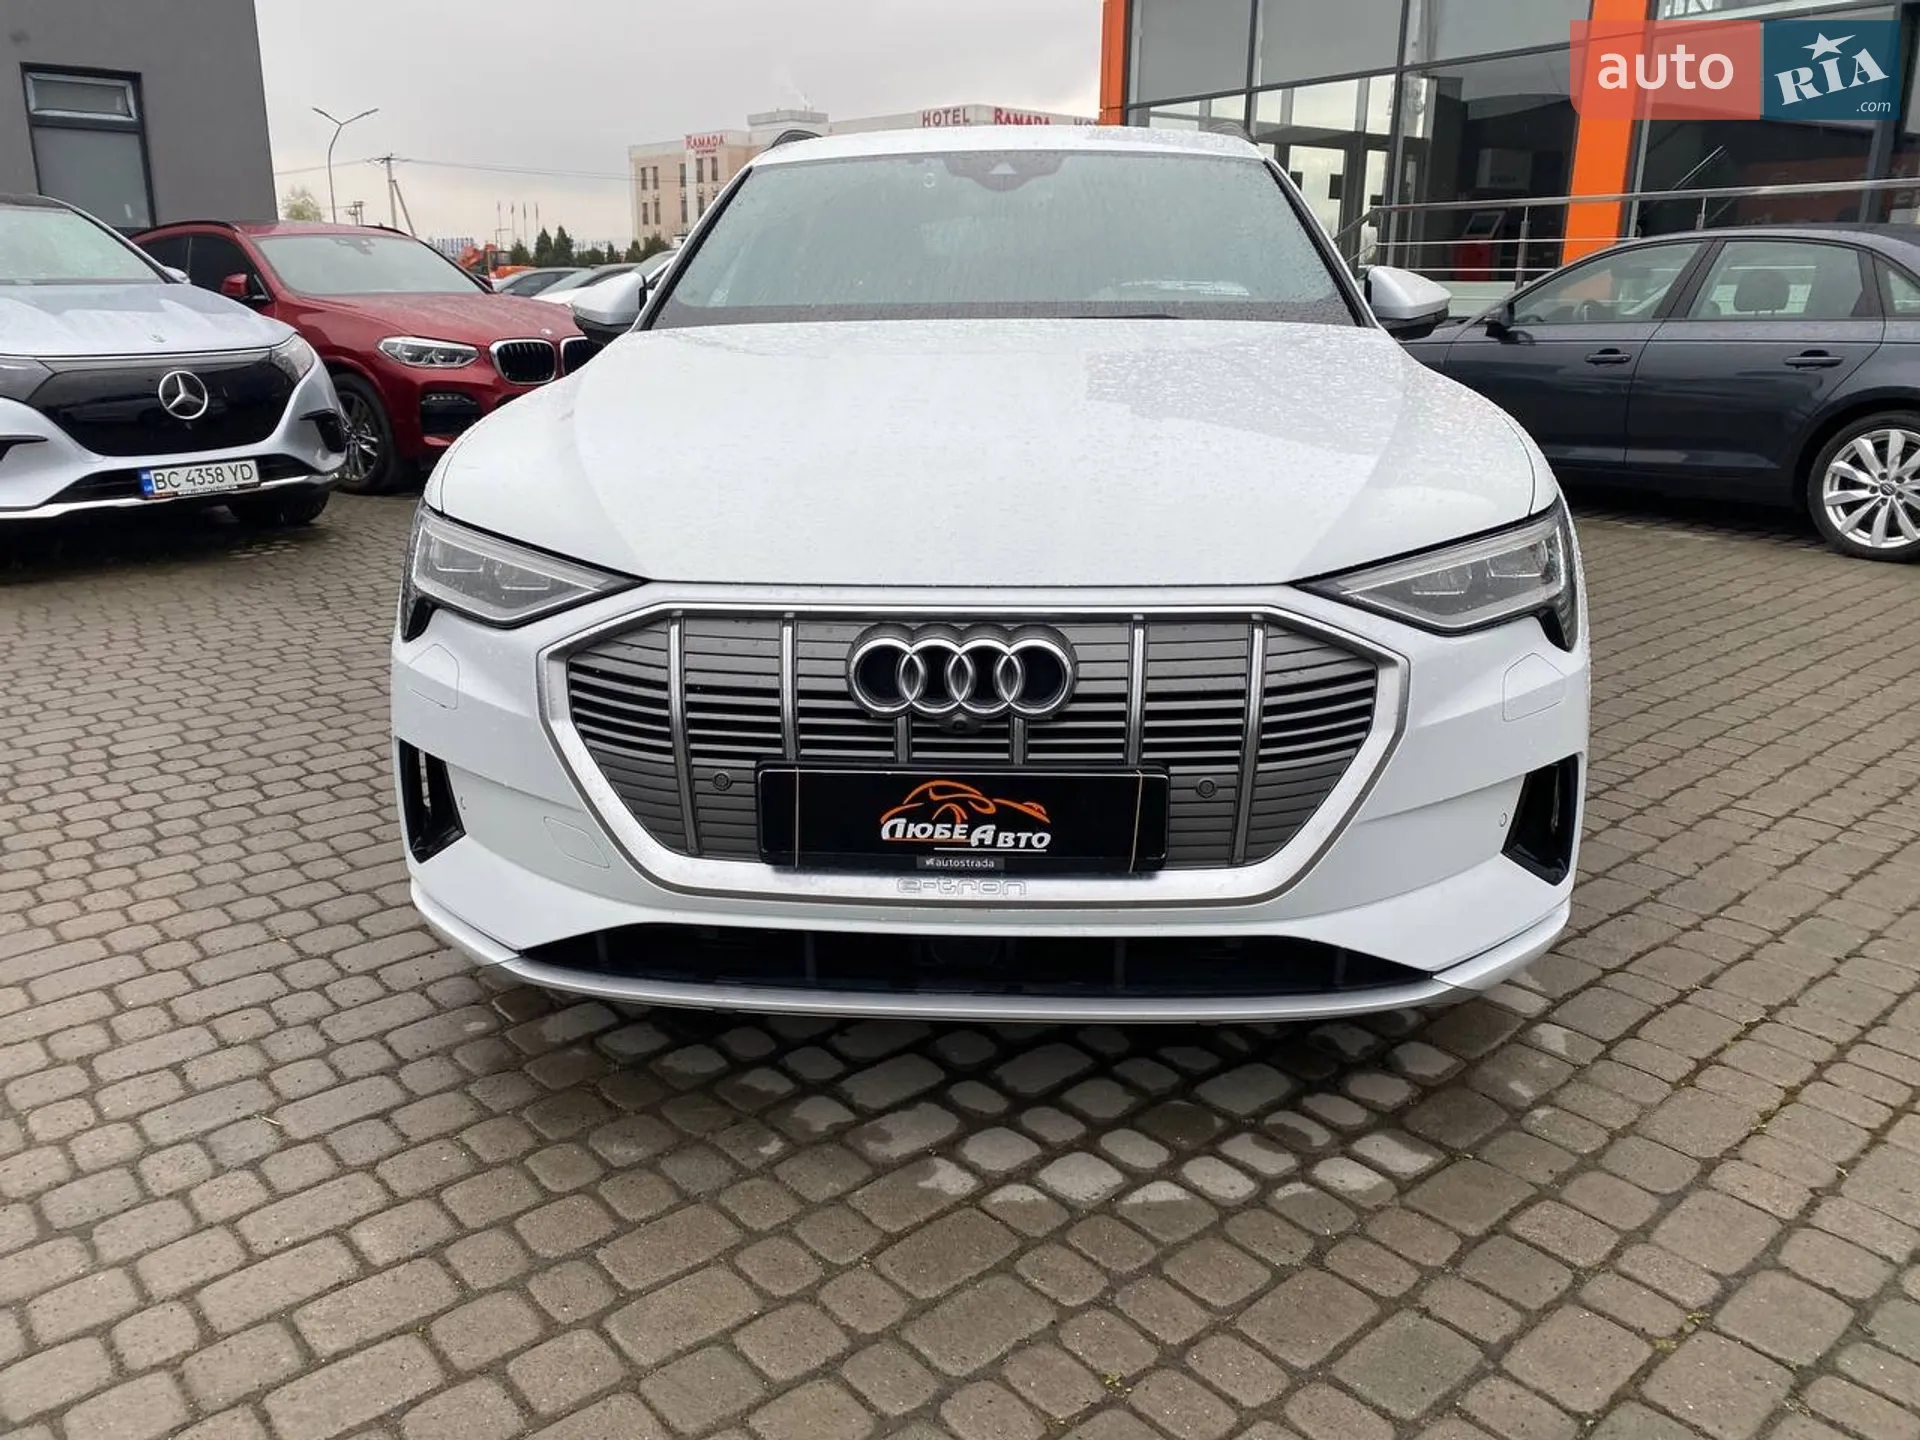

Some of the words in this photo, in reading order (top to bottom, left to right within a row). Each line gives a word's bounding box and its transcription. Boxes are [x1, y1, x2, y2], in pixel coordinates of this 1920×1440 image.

[922, 107, 970, 127] HOTEL
[684, 134, 725, 150] RAMADA
[153, 471, 181, 490] BC
[185, 466, 225, 486] 4358
[227, 463, 254, 481] YD
[896, 877, 1028, 896] e-tron
